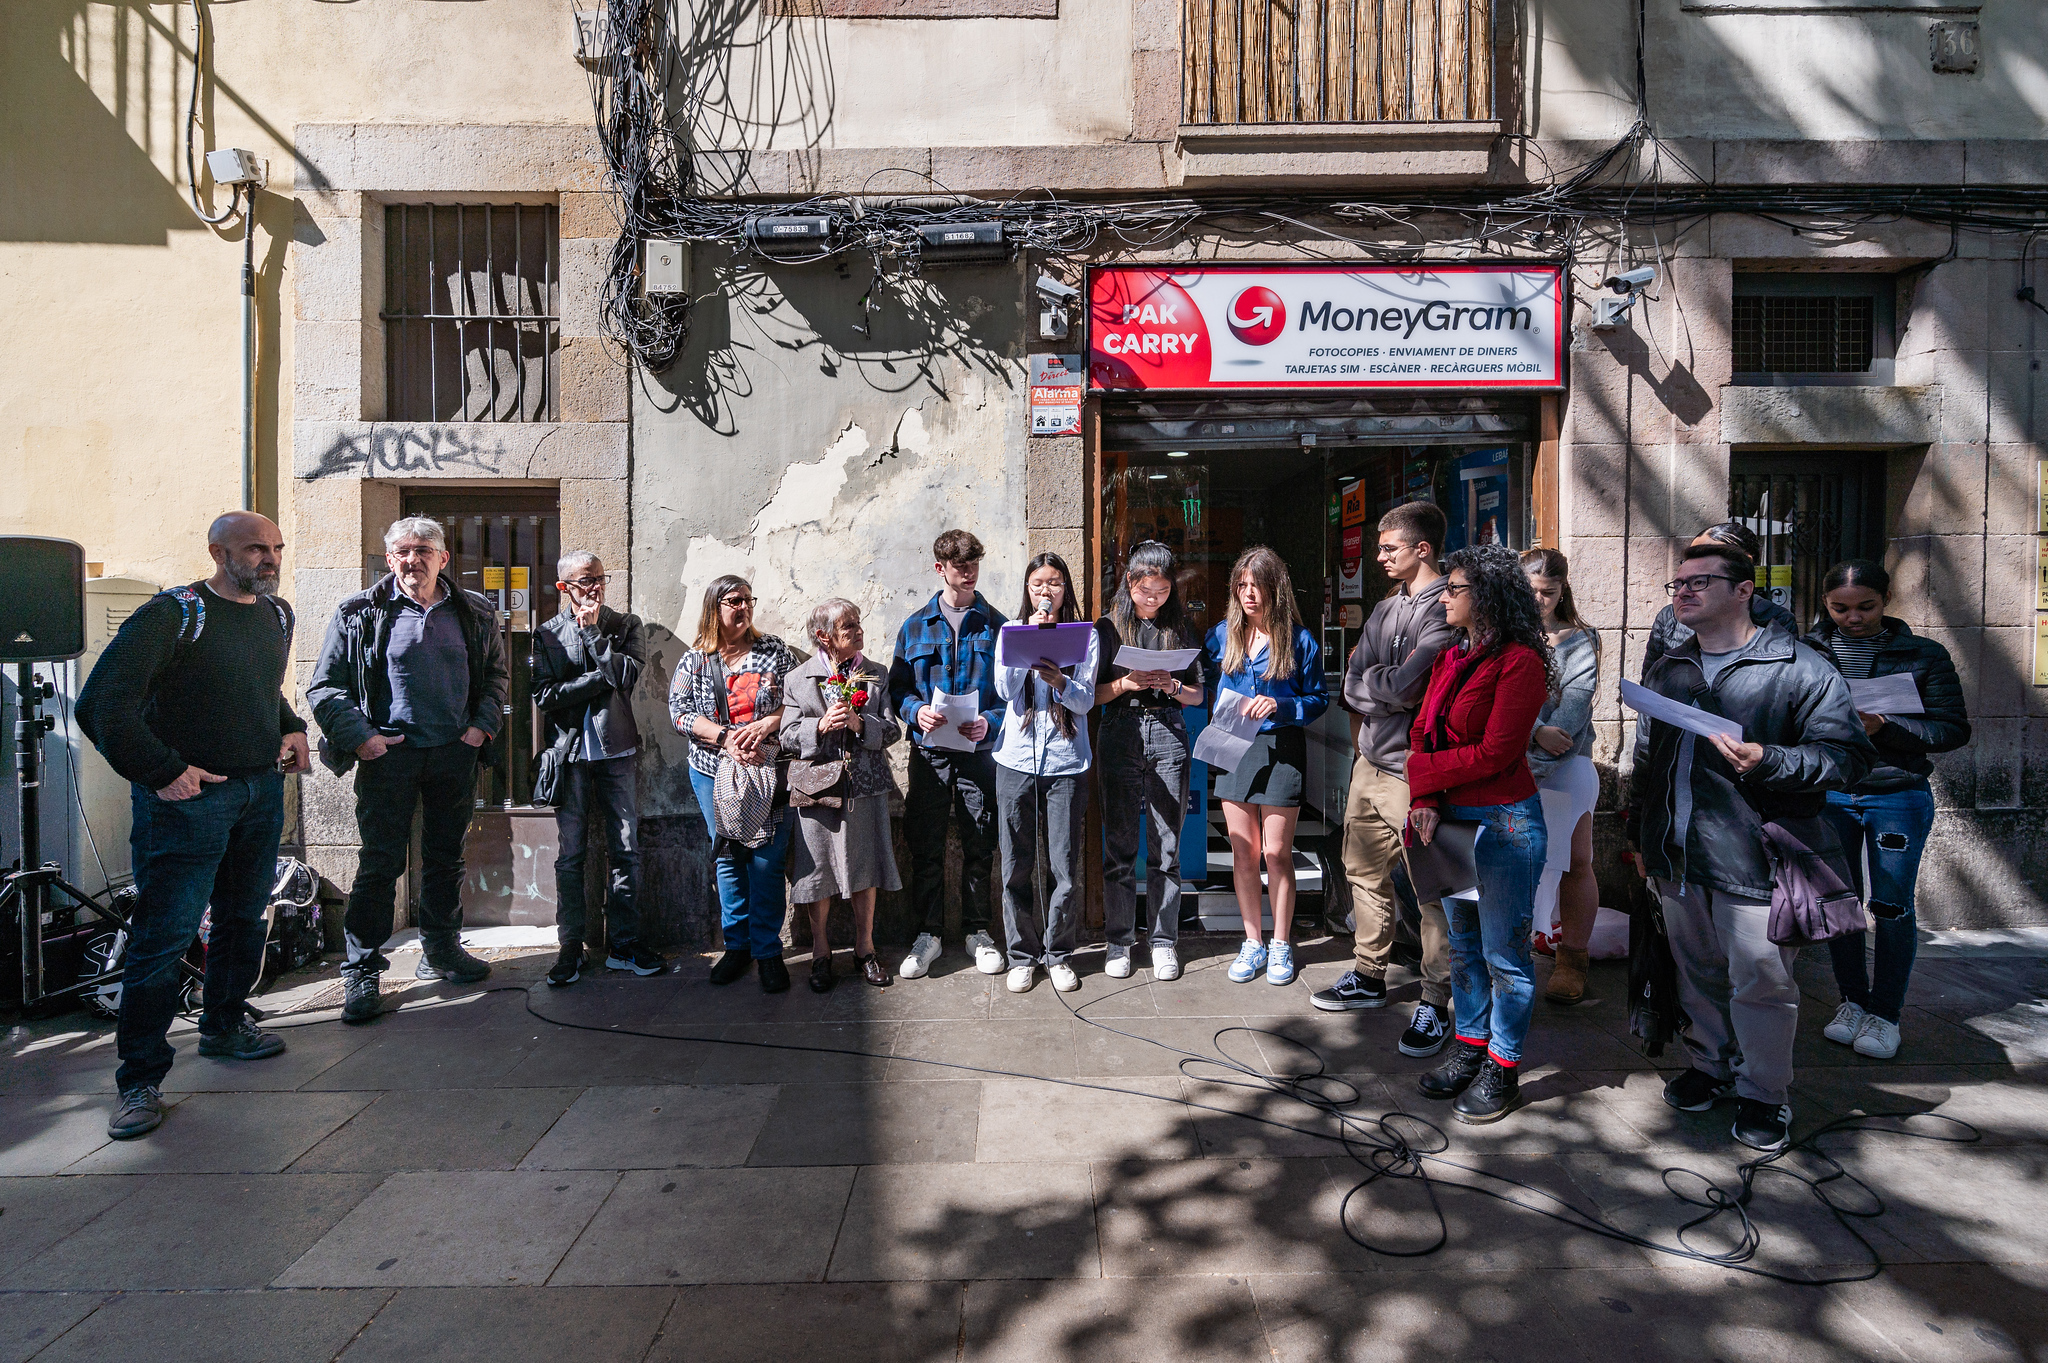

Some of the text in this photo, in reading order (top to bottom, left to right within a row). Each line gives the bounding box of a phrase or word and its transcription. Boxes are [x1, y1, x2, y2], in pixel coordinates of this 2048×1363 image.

[580, 18, 610, 47] 38
[1943, 29, 1974, 56] 36
[945, 232, 974, 240] 511682
[1122, 304, 1178, 324] PAK
[1298, 299, 1532, 339] MoneyGram
[1103, 333, 1199, 354] CARRY
[1309, 346, 1518, 357] FOTOCOPIES ENVIAMENT DE DINERS
[1285, 361, 1542, 374] TARJETAS SIM ESCÀNER RECÀRGUERS MÒBIL
[1034, 388, 1078, 398] Alarma
[1346, 494, 1361, 514] Ria
